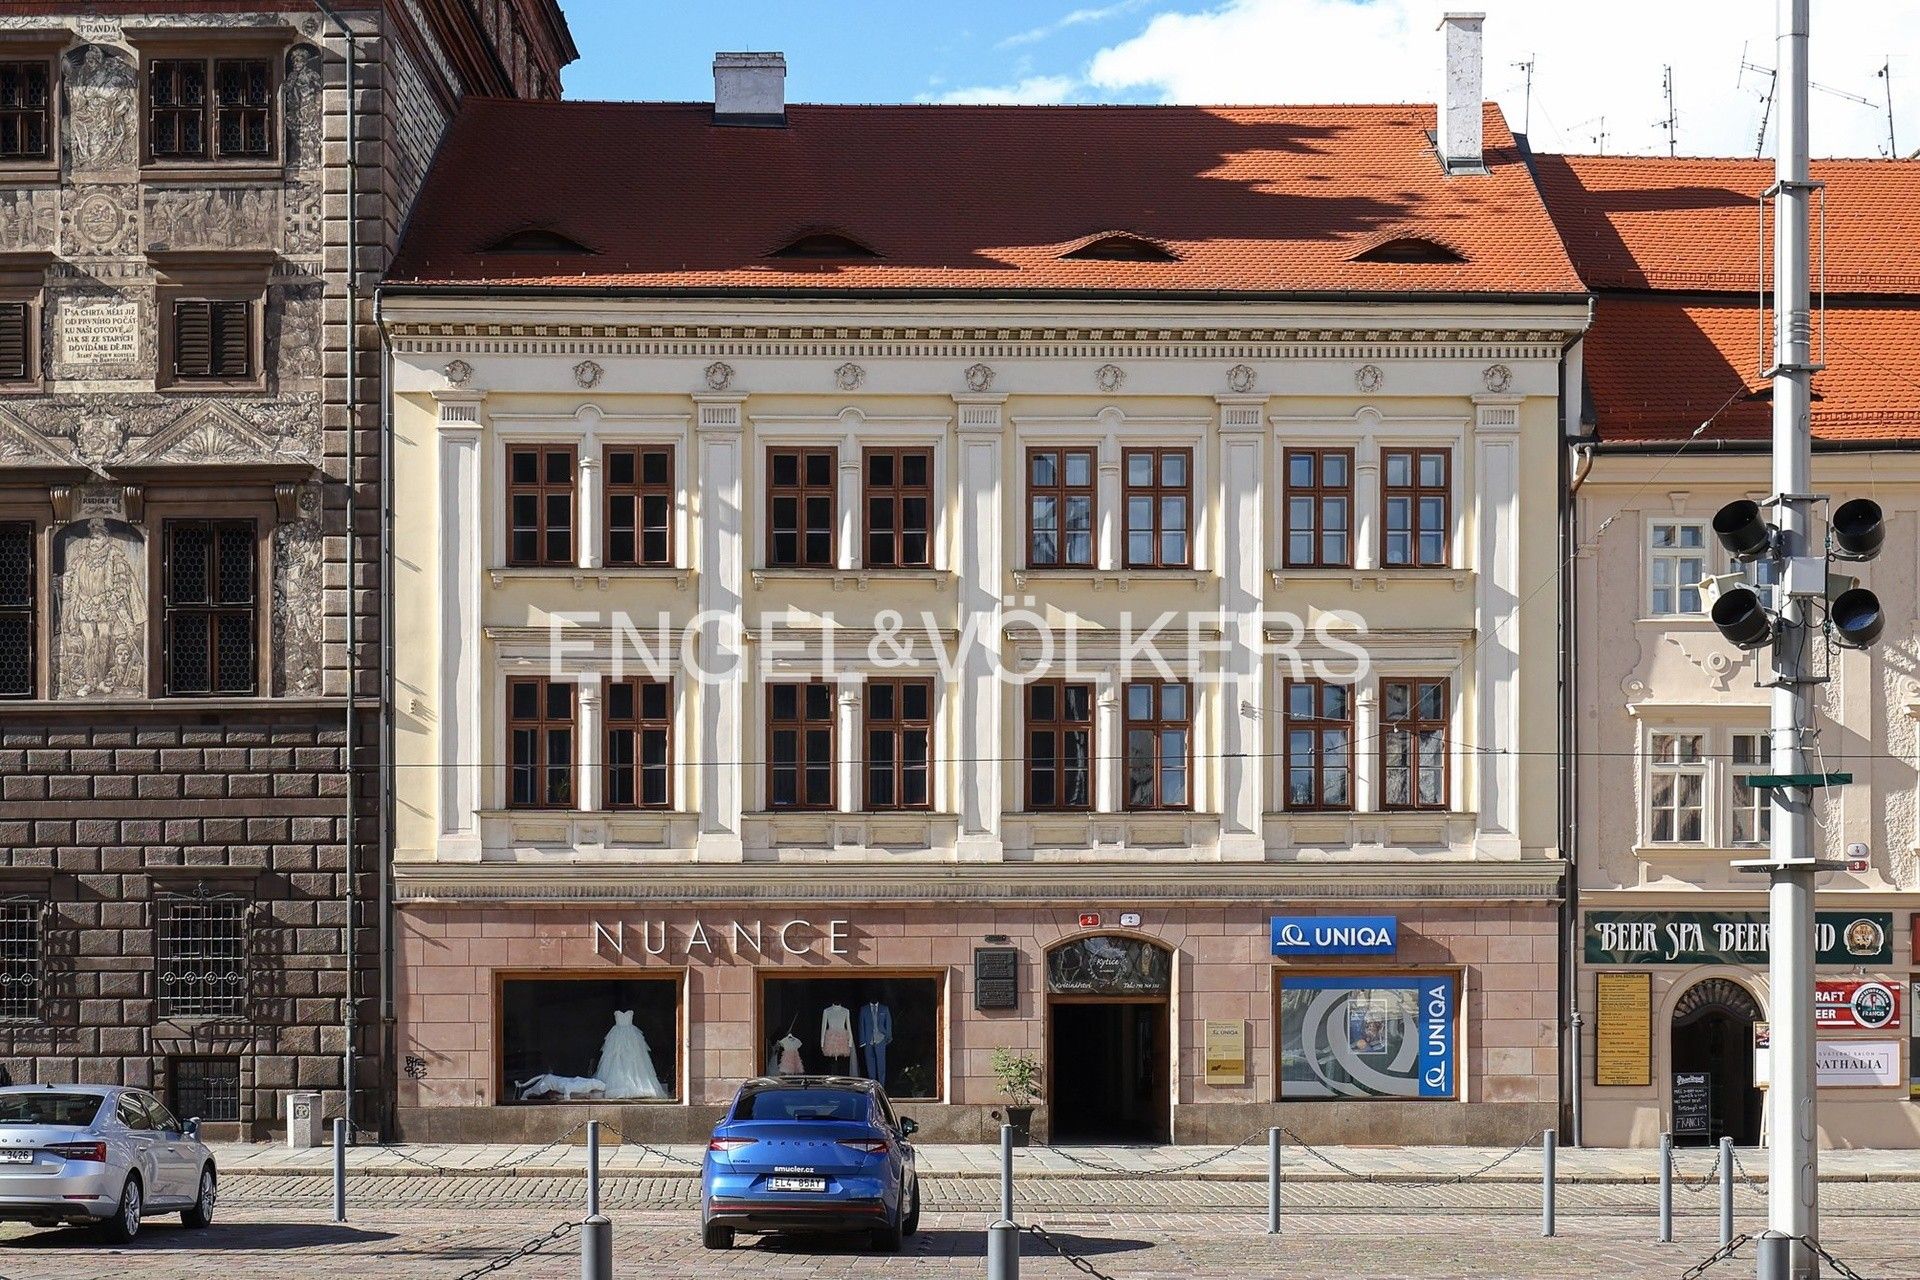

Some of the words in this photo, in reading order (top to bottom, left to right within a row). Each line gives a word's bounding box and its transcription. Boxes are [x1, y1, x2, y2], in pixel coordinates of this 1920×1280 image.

[80, 25, 117, 33] PRAVDA
[78, 316, 111, 325] PRVNÍHO
[76, 325, 92, 334] NAŠI
[66, 335, 80, 343] JAK
[91, 335, 100, 343] ZE
[1087, 916, 1093, 924] 2
[1127, 916, 1133, 924] 2
[594, 919, 848, 955] NUANCE
[1315, 927, 1393, 947] UNIQA
[1594, 922, 1658, 952] BEER
[1665, 922, 1705, 960] SPA
[1815, 991, 1846, 1002] RAFT
[1815, 1009, 1837, 1019] EER
[1861, 1010, 1885, 1018] FRANCIS
[1428, 984, 1446, 1056] UNIQA
[7, 1150, 29, 1160] 3426
